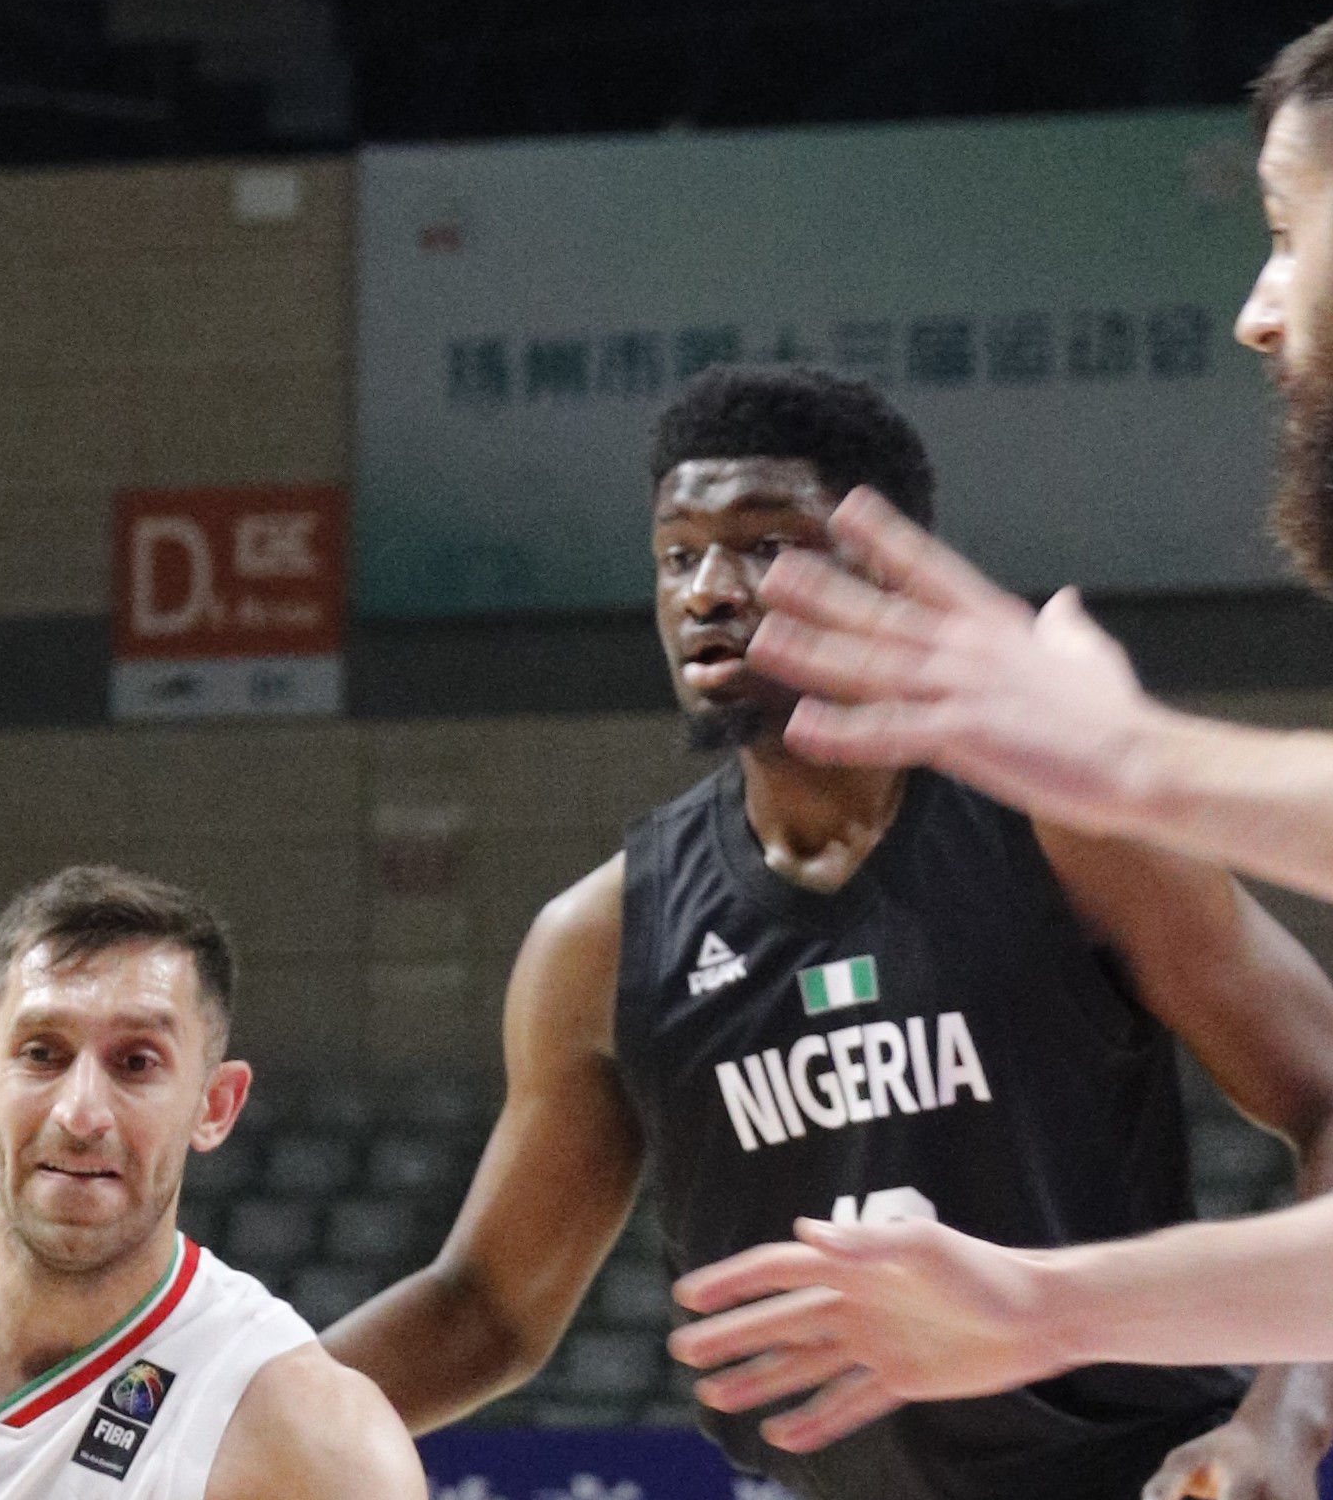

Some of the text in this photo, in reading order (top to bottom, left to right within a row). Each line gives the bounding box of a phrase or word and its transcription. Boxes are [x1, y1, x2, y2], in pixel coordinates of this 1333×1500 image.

[687, 954, 747, 995] PEAK
[715, 1011, 993, 1152] NIGERIA
[93, 1418, 136, 1450] FIBA
